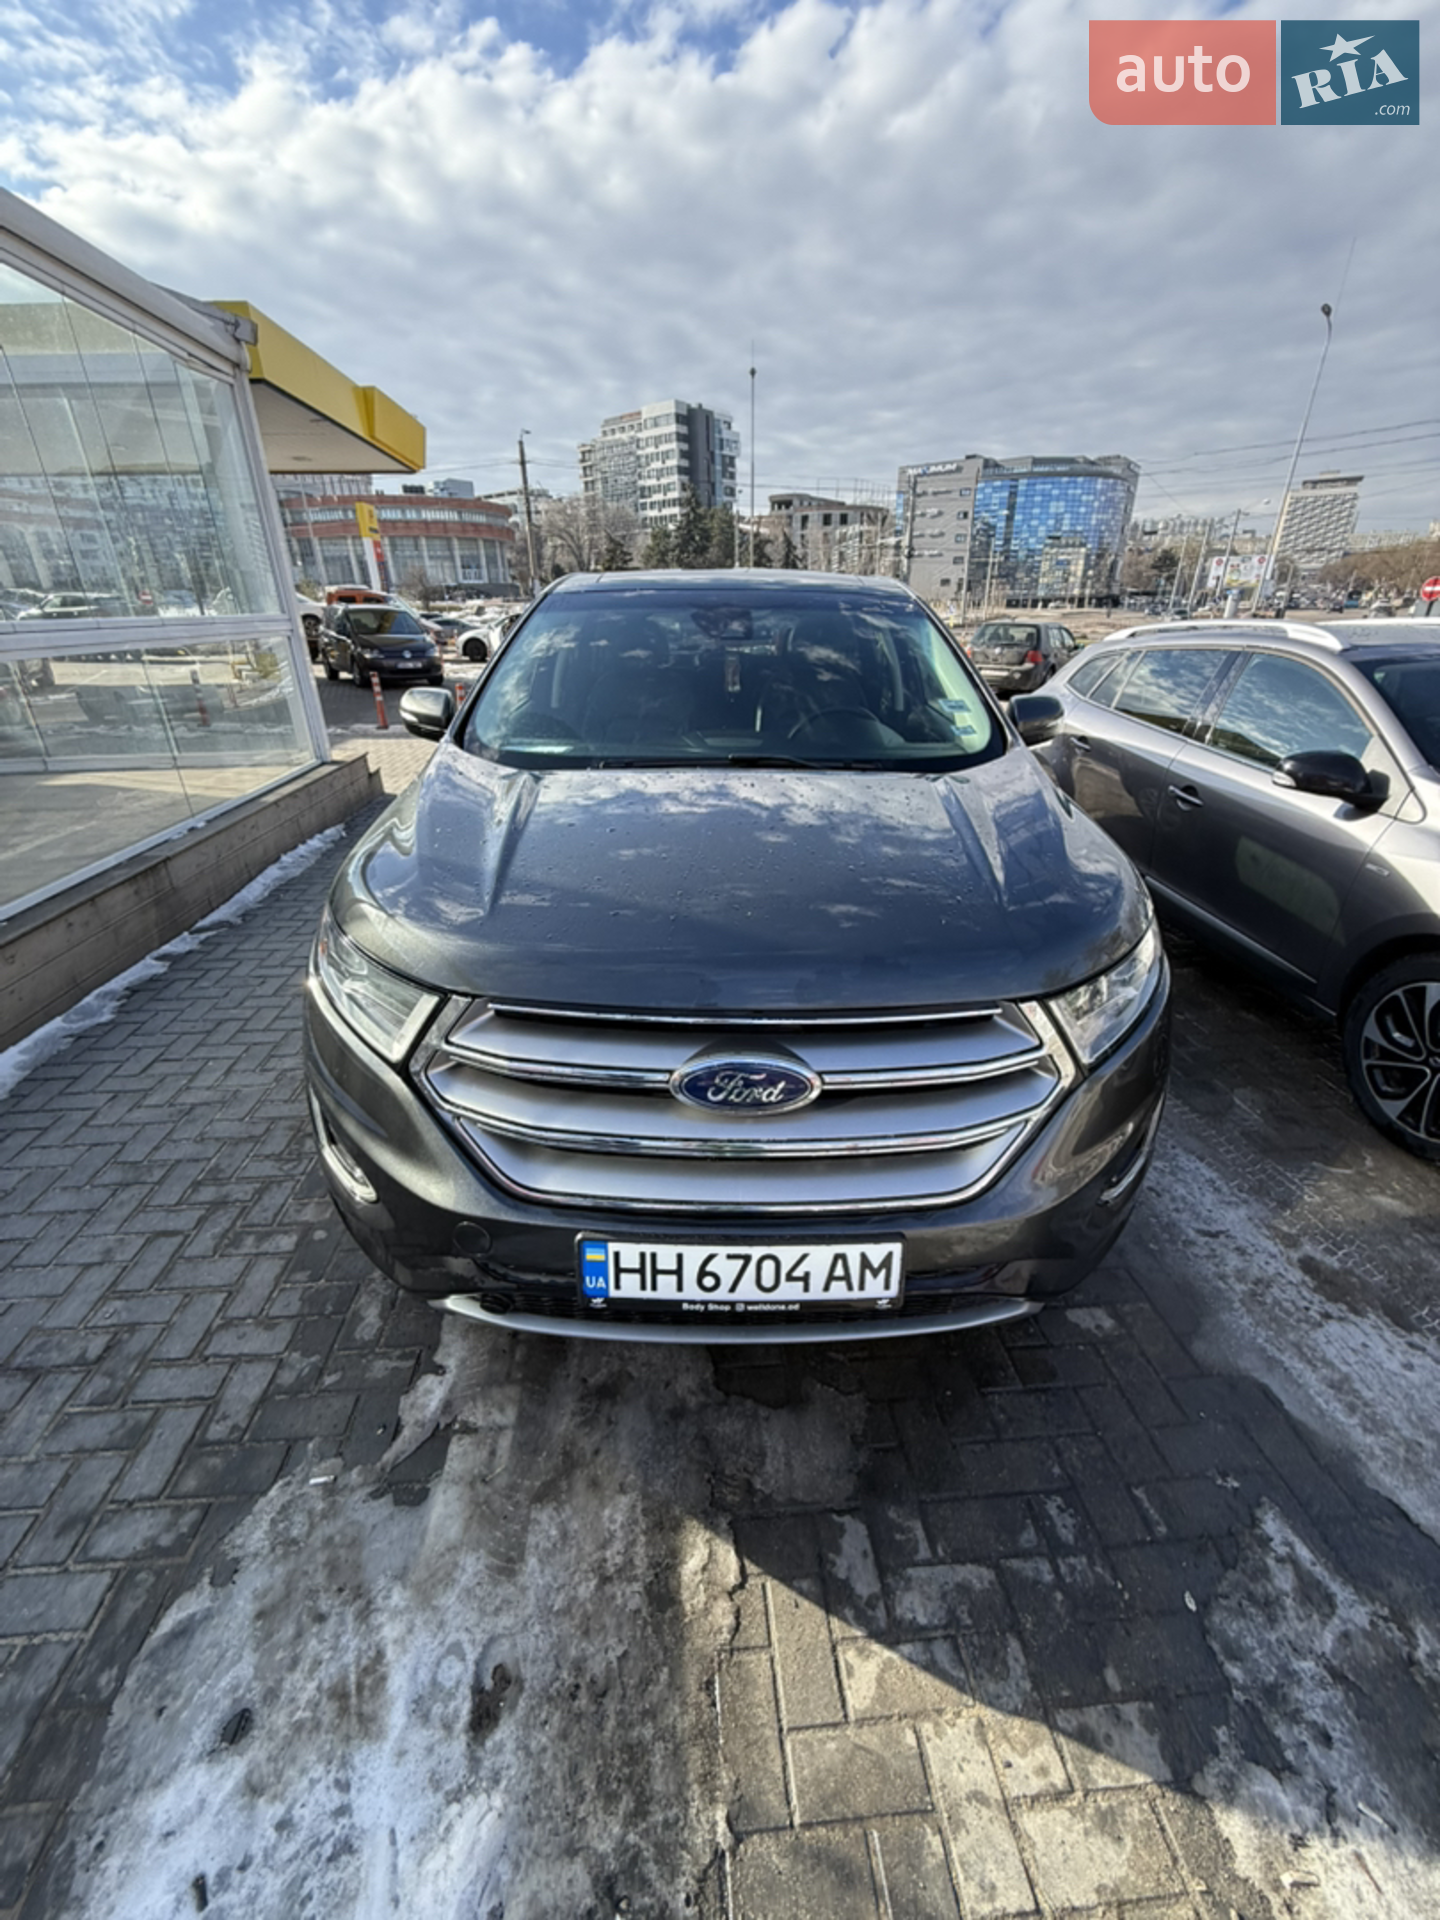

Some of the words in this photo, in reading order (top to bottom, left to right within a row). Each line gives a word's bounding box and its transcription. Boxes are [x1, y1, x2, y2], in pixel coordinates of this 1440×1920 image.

[707, 1071, 786, 1102] Ford
[586, 1276, 606, 1288] UA
[613, 1251, 683, 1292] HH
[696, 1253, 811, 1293] 6704
[822, 1251, 894, 1292] AM
[681, 1301, 704, 1312] Body
[707, 1301, 731, 1311] Shop
